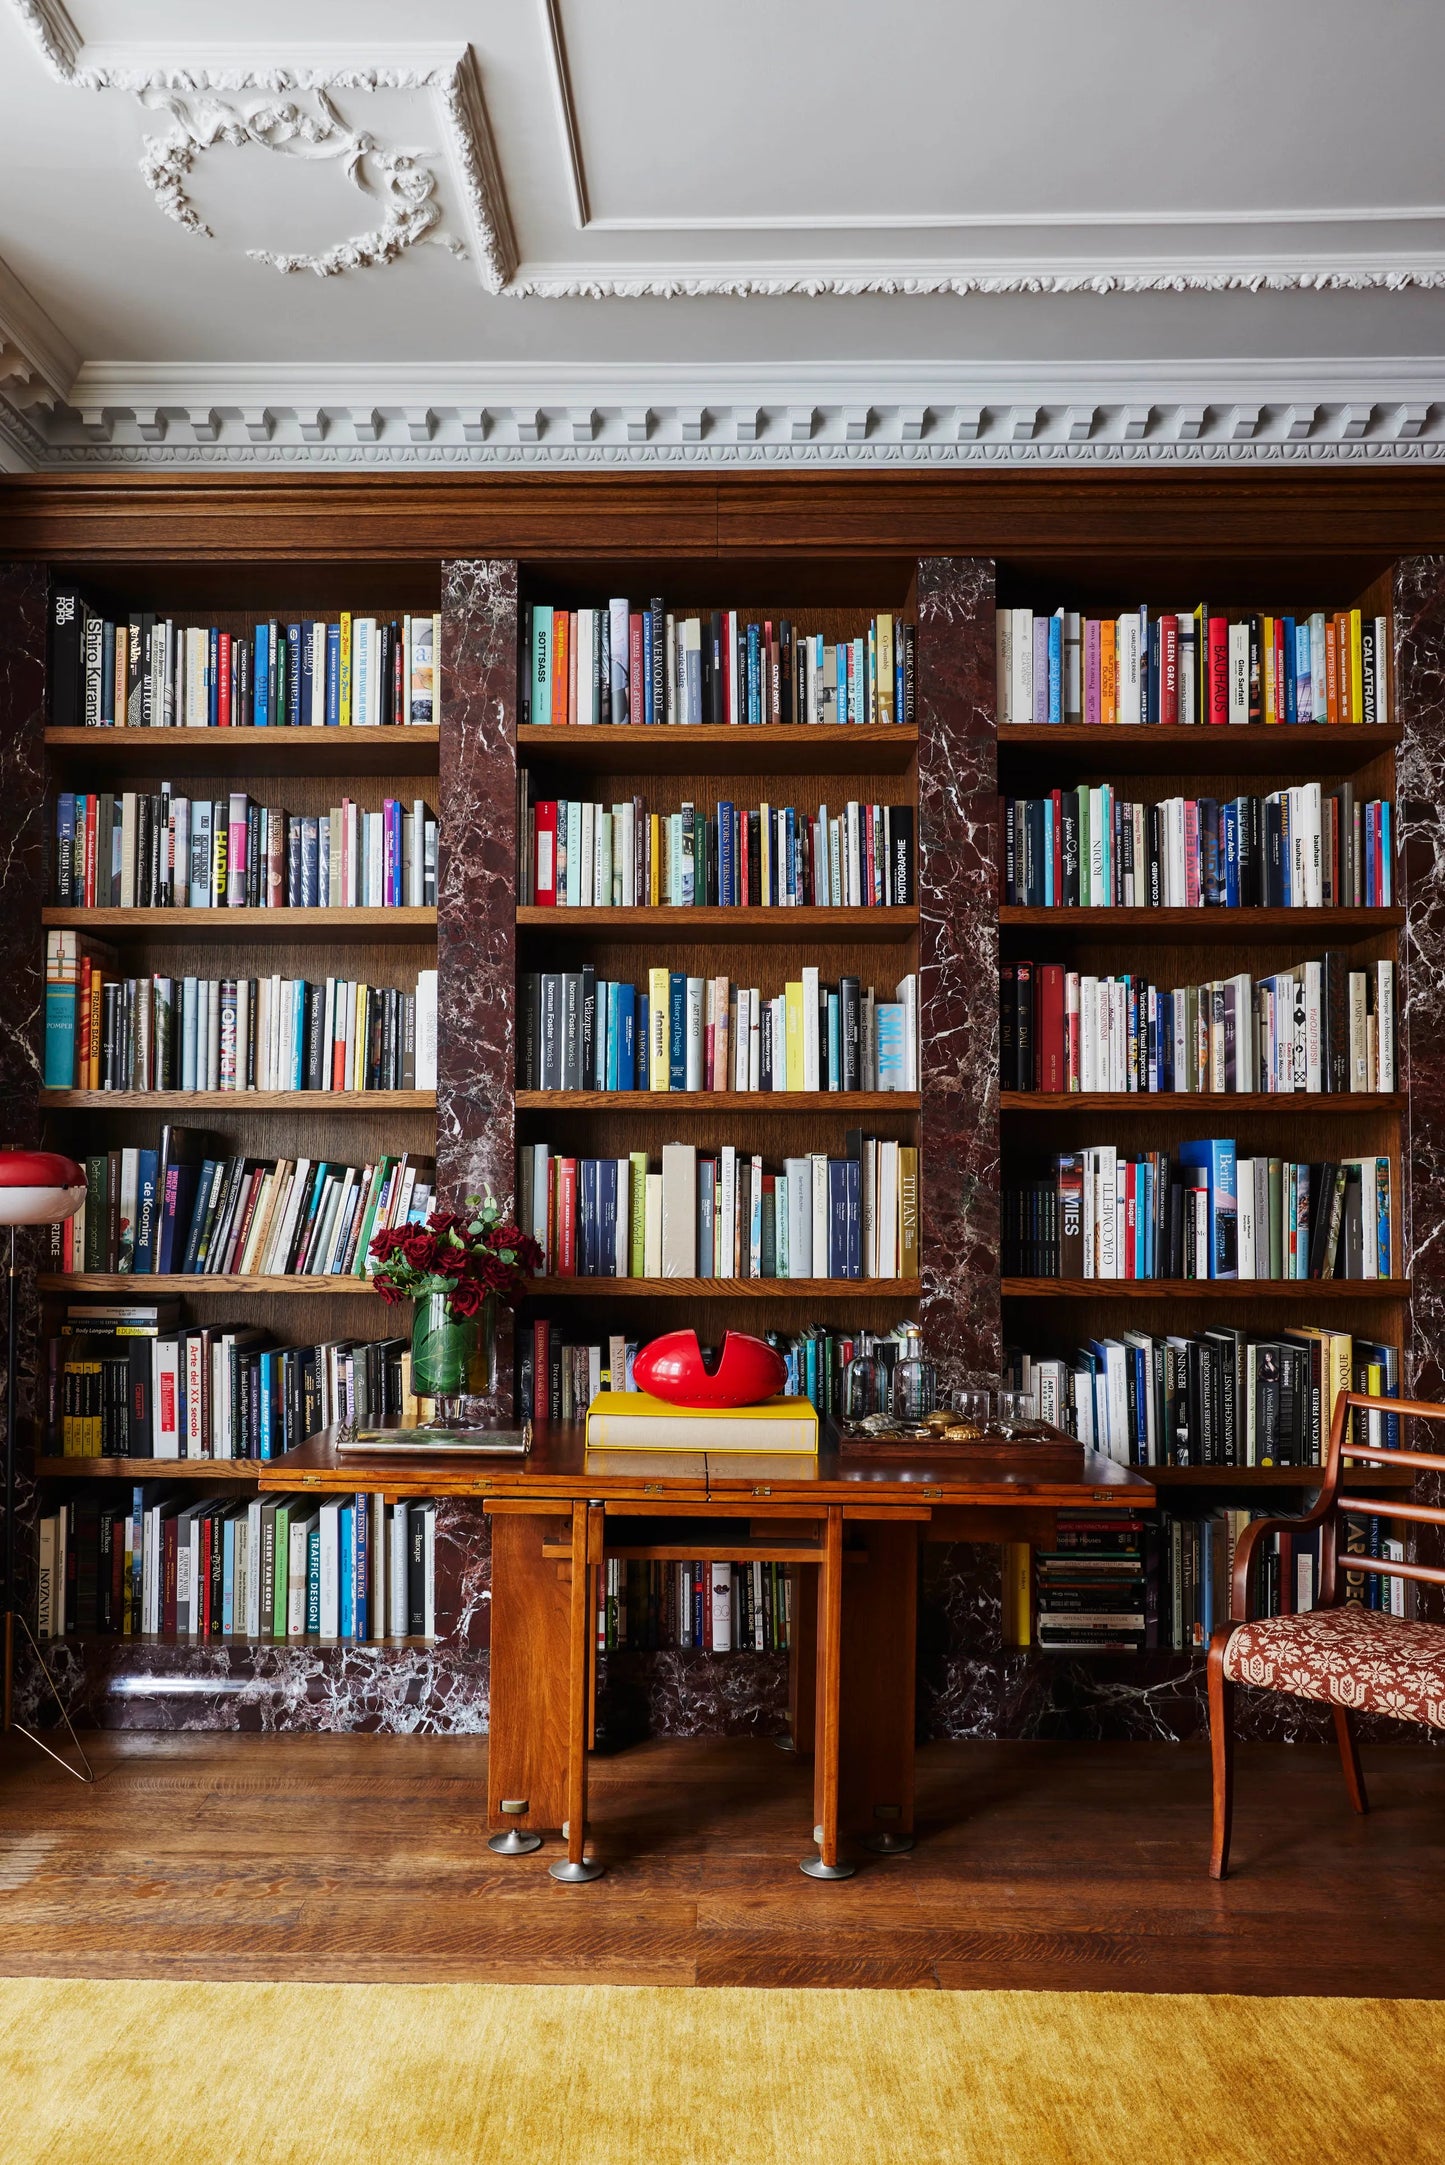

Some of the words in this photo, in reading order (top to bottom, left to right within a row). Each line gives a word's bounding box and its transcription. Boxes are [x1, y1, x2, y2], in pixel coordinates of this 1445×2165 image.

[56, 597, 65, 625] FORD
[65, 597, 74, 620] TOM
[654, 606, 663, 636] AXEL
[88, 622, 101, 662] Shiro
[538, 631, 546, 682] SOTTSASS
[1167, 631, 1175, 662] EILEEN
[906, 640, 914, 678] AMERICAN
[289, 644, 299, 709] Frankreich
[654, 640, 663, 711] VERVOORDT
[906, 679, 914, 694] ART
[1167, 666, 1175, 692] GRAY
[1214, 646, 1226, 712] BAUHAUS
[1363, 636, 1374, 724] CALATRAVA
[143, 693, 151, 720] DECO
[906, 696, 914, 718] DECO
[62, 824, 70, 836] LE
[200, 816, 209, 828] LE
[722, 806, 730, 842] VISITORS
[1062, 817, 1076, 841] pierre
[192, 835, 200, 846] LE
[722, 844, 730, 856] TO
[62, 839, 70, 895] CORBUSIER
[192, 852, 200, 882] GRAND
[200, 835, 209, 889] CORBUSIER
[214, 830, 227, 894] HADID
[330, 850, 340, 880] Ponti
[897, 840, 906, 904] PHOTOGRAPHIE
[1062, 853, 1076, 876] gilles
[1092, 840, 1102, 876] RODIN
[1204, 830, 1217, 888] ANDO
[722, 858, 730, 906] VERSAILLES
[312, 992, 320, 1019] Venice.
[546, 982, 555, 1011] Norman
[674, 994, 682, 1022] History
[546, 1014, 555, 1038] Foster
[583, 996, 594, 1042] Velázquez
[655, 1010, 664, 1056] domus
[222, 1009, 236, 1070] PIANO
[310, 1025, 318, 1050] Visions
[546, 1040, 555, 1062] Works
[638, 1030, 646, 1072] BAROQUE
[674, 1031, 682, 1056] Design
[877, 1008, 902, 1074] S,M,L,XL
[1020, 1026, 1028, 1048] DALÍ
[310, 1058, 318, 1076] Glass
[170, 1170, 178, 1188] WHEN
[1219, 1154, 1232, 1194] Berlin
[144, 1182, 153, 1196] de
[164, 1189, 172, 1203] POP
[168, 1189, 176, 1216] BRITAIN
[632, 1178, 642, 1214] Modern
[904, 1175, 915, 1227] TITIAN
[139, 1198, 152, 1246] Kooning
[1065, 1192, 1079, 1236] MIES
[1102, 1183, 1114, 1265] GIACOMETTI
[51, 1223, 60, 1256] RINCE
[632, 1216, 642, 1245] World
[190, 1346, 199, 1367] Arte
[1178, 1352, 1186, 1389] BERNINI
[190, 1371, 199, 1385] del
[240, 1370, 248, 1385] Frank
[240, 1386, 248, 1398] Lloyd
[1204, 1351, 1212, 1408] MYTHOLOGIQUES
[190, 1388, 199, 1403] XX
[240, 1399, 248, 1415] Wright
[190, 1407, 199, 1437] secolo
[240, 1415, 248, 1432] Natural
[1204, 1409, 1212, 1448] ALLÉGORIES
[240, 1433, 248, 1449] Design
[1204, 1449, 1212, 1460] LES
[357, 1494, 365, 1511] ARIO
[357, 1513, 365, 1543] TESTINO
[310, 1537, 319, 1578] TRAFFIC
[414, 1534, 422, 1562] Baroque
[212, 1554, 220, 1581] PIANO
[357, 1561, 365, 1580] YOUR
[40, 1568, 50, 1625] MANZONI
[310, 1583, 319, 1622] DESIGN
[357, 1582, 365, 1599] FACE
